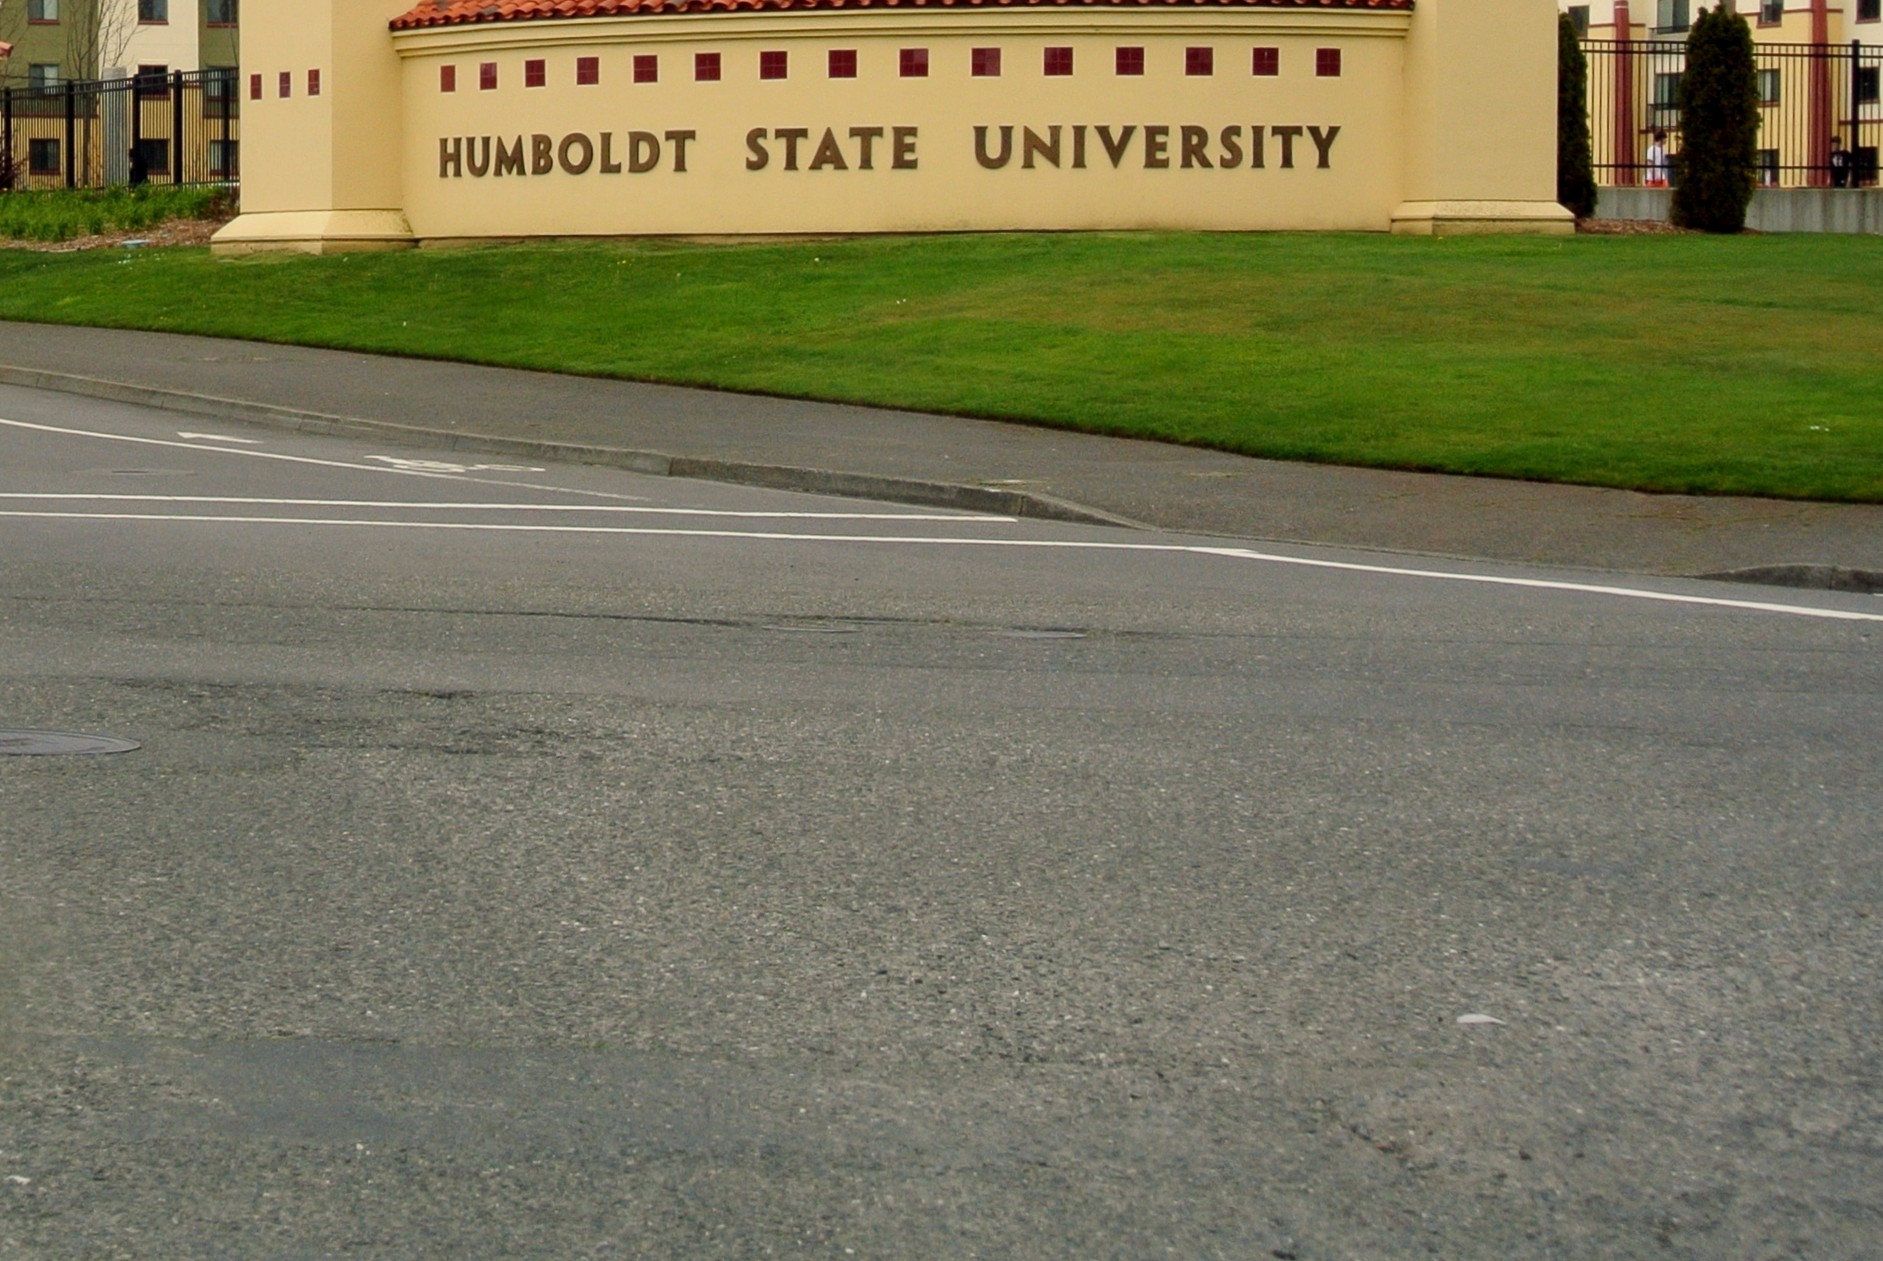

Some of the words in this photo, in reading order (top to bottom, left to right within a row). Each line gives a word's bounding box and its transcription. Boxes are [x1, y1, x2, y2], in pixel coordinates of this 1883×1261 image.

[439, 131, 697, 179] HUMBOLDT
[745, 126, 919, 172] STATE
[973, 125, 1342, 171] UNIVERSITY
